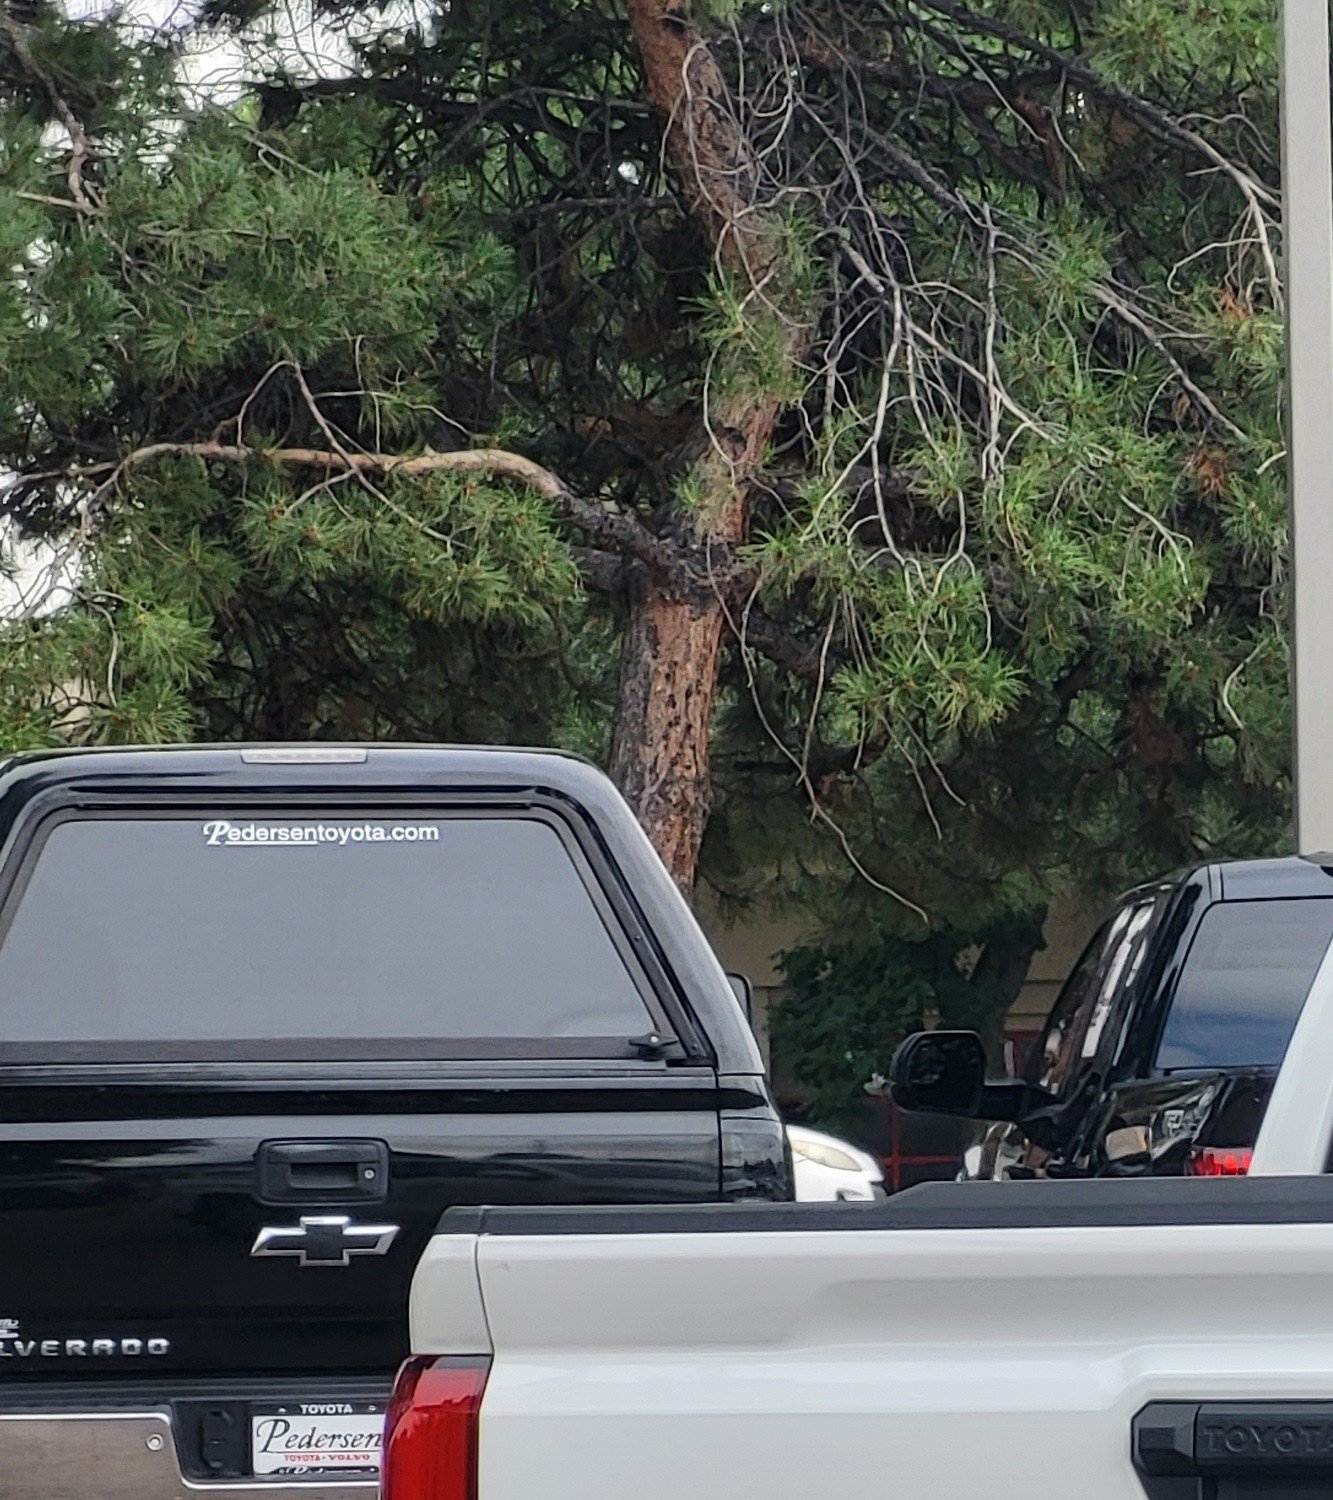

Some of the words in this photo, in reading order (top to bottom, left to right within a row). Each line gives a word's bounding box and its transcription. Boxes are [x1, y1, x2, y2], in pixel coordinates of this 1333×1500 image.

[203, 820, 439, 845] Pedersentoyota.com
[300, 1404, 353, 1414] TOYOTA
[256, 1418, 383, 1453] Pedersen
